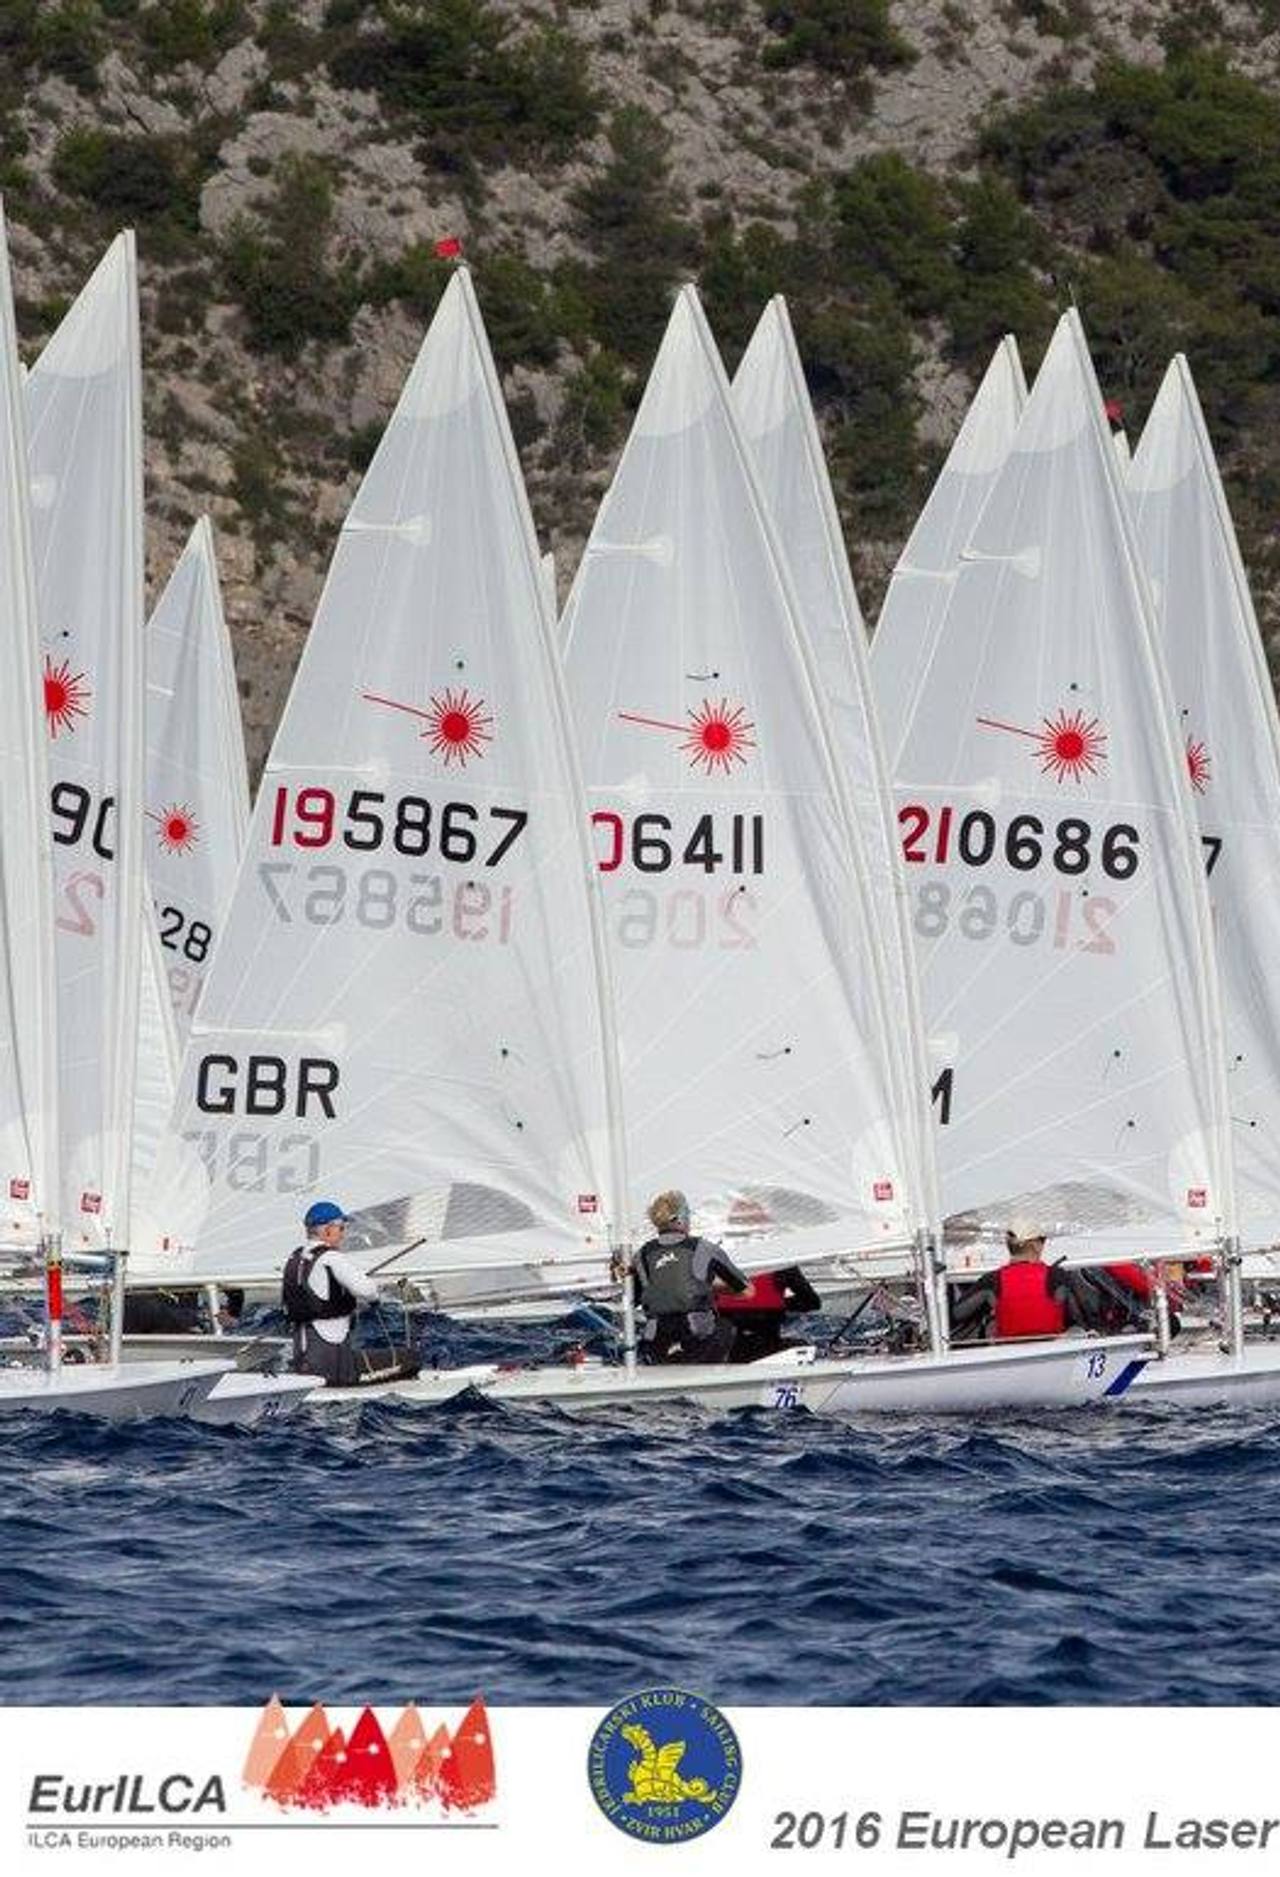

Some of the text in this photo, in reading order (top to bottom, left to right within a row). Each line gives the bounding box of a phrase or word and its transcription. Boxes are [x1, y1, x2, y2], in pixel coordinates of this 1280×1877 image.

[272, 787, 529, 867] 195867
[897, 806, 1140, 880] 210686
[153, 901, 212, 963] 28
[197, 1054, 340, 1119] GBR
[1087, 1353, 1107, 1379] 13
